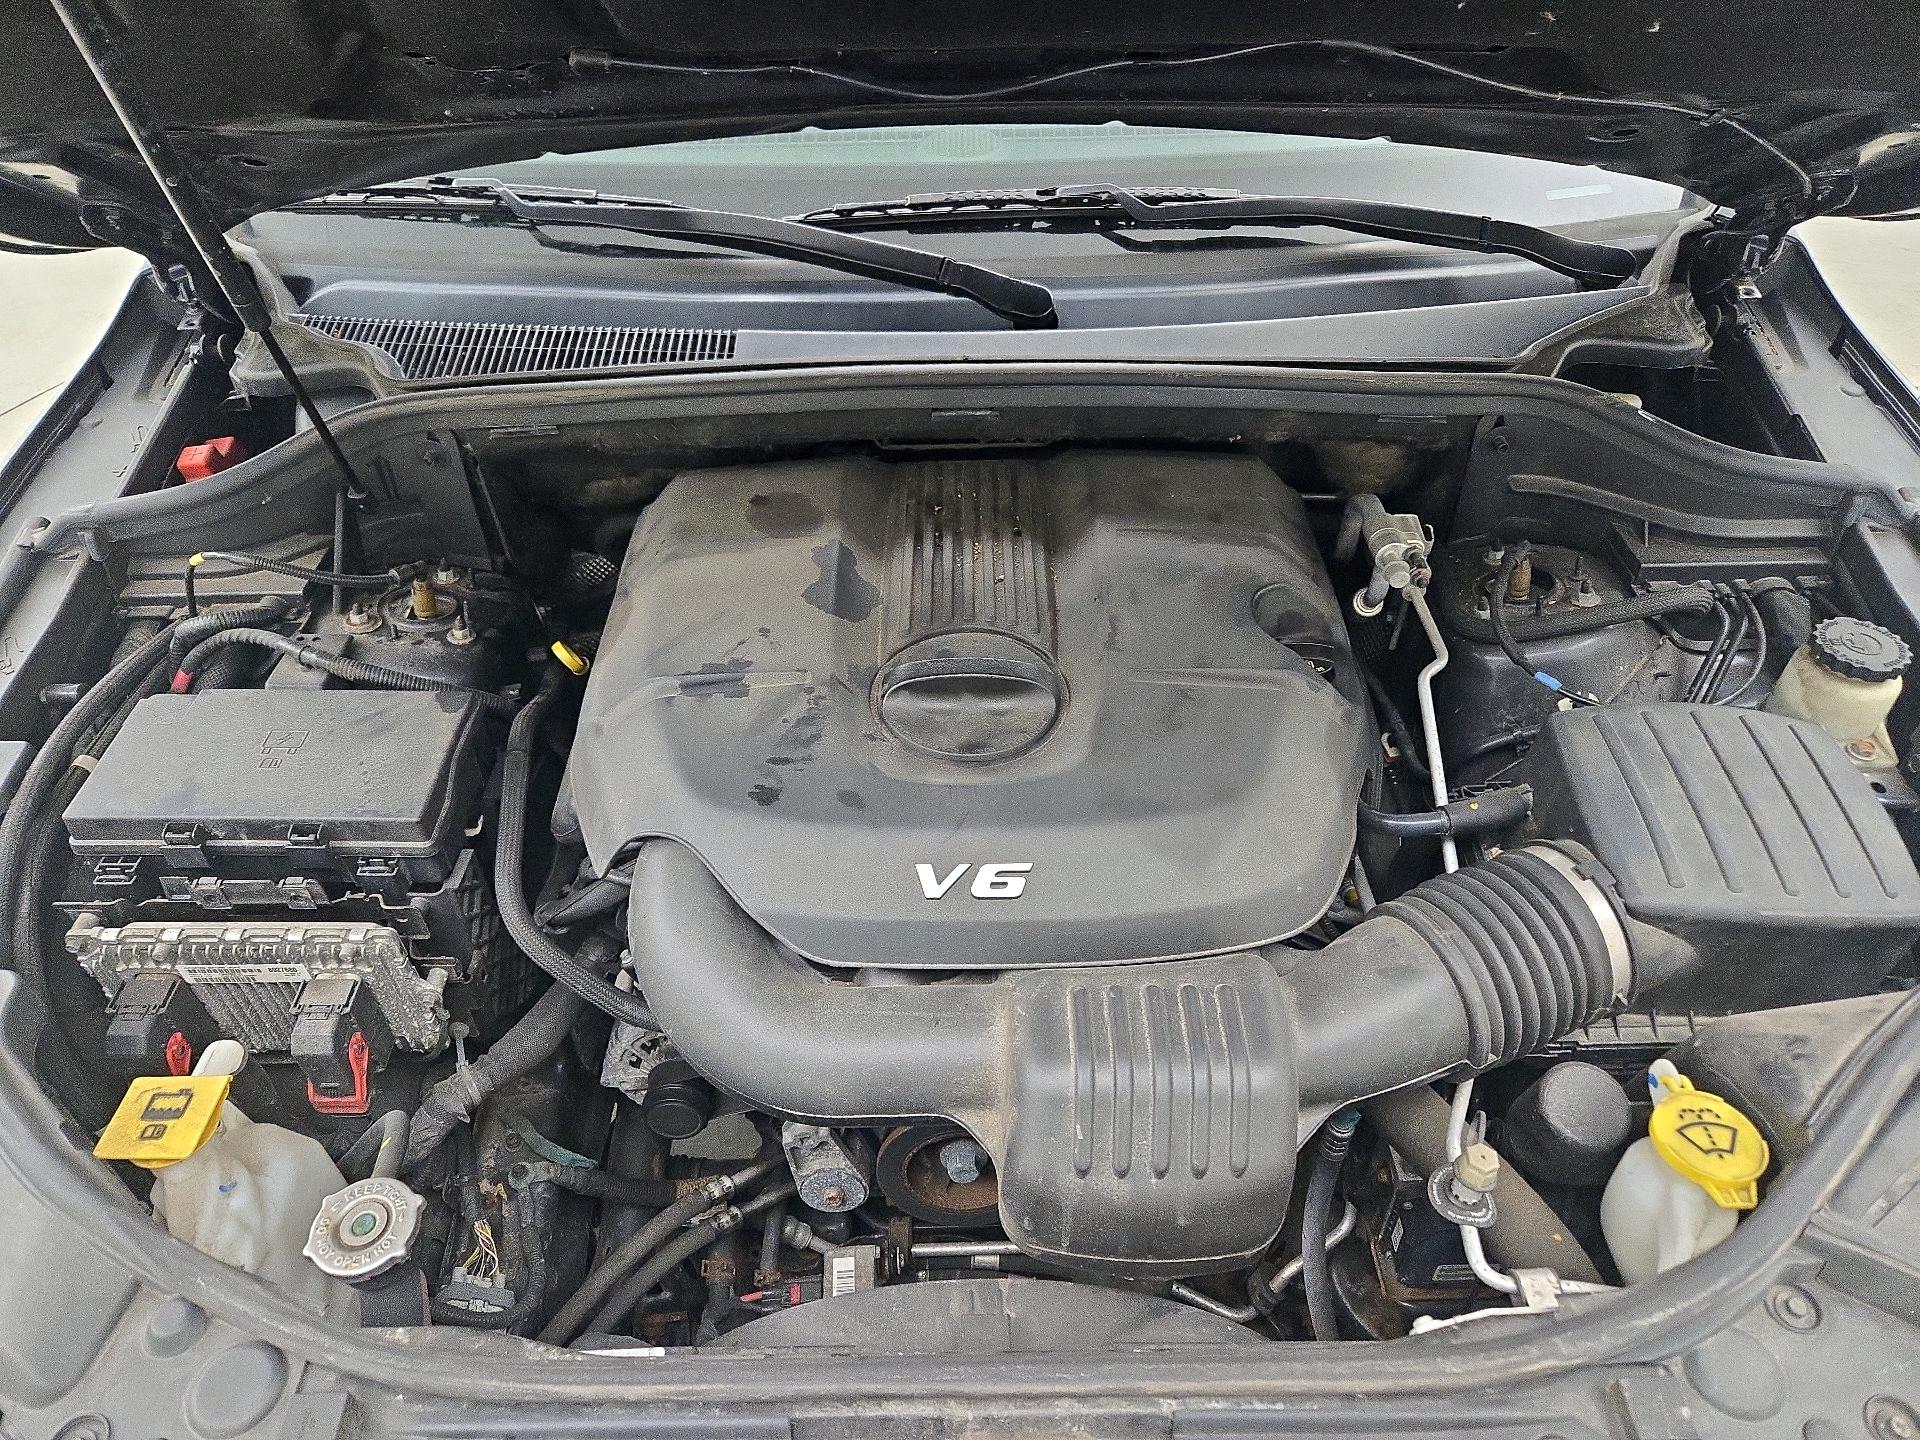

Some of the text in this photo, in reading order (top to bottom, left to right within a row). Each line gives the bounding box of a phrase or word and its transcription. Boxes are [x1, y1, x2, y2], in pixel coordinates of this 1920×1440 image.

[914, 862, 1034, 900] V6
[344, 1182, 382, 1201] KEEP
[316, 1240, 336, 1259] NOT
[334, 1253, 371, 1268] OPEN
[373, 1233, 397, 1256] HOT
